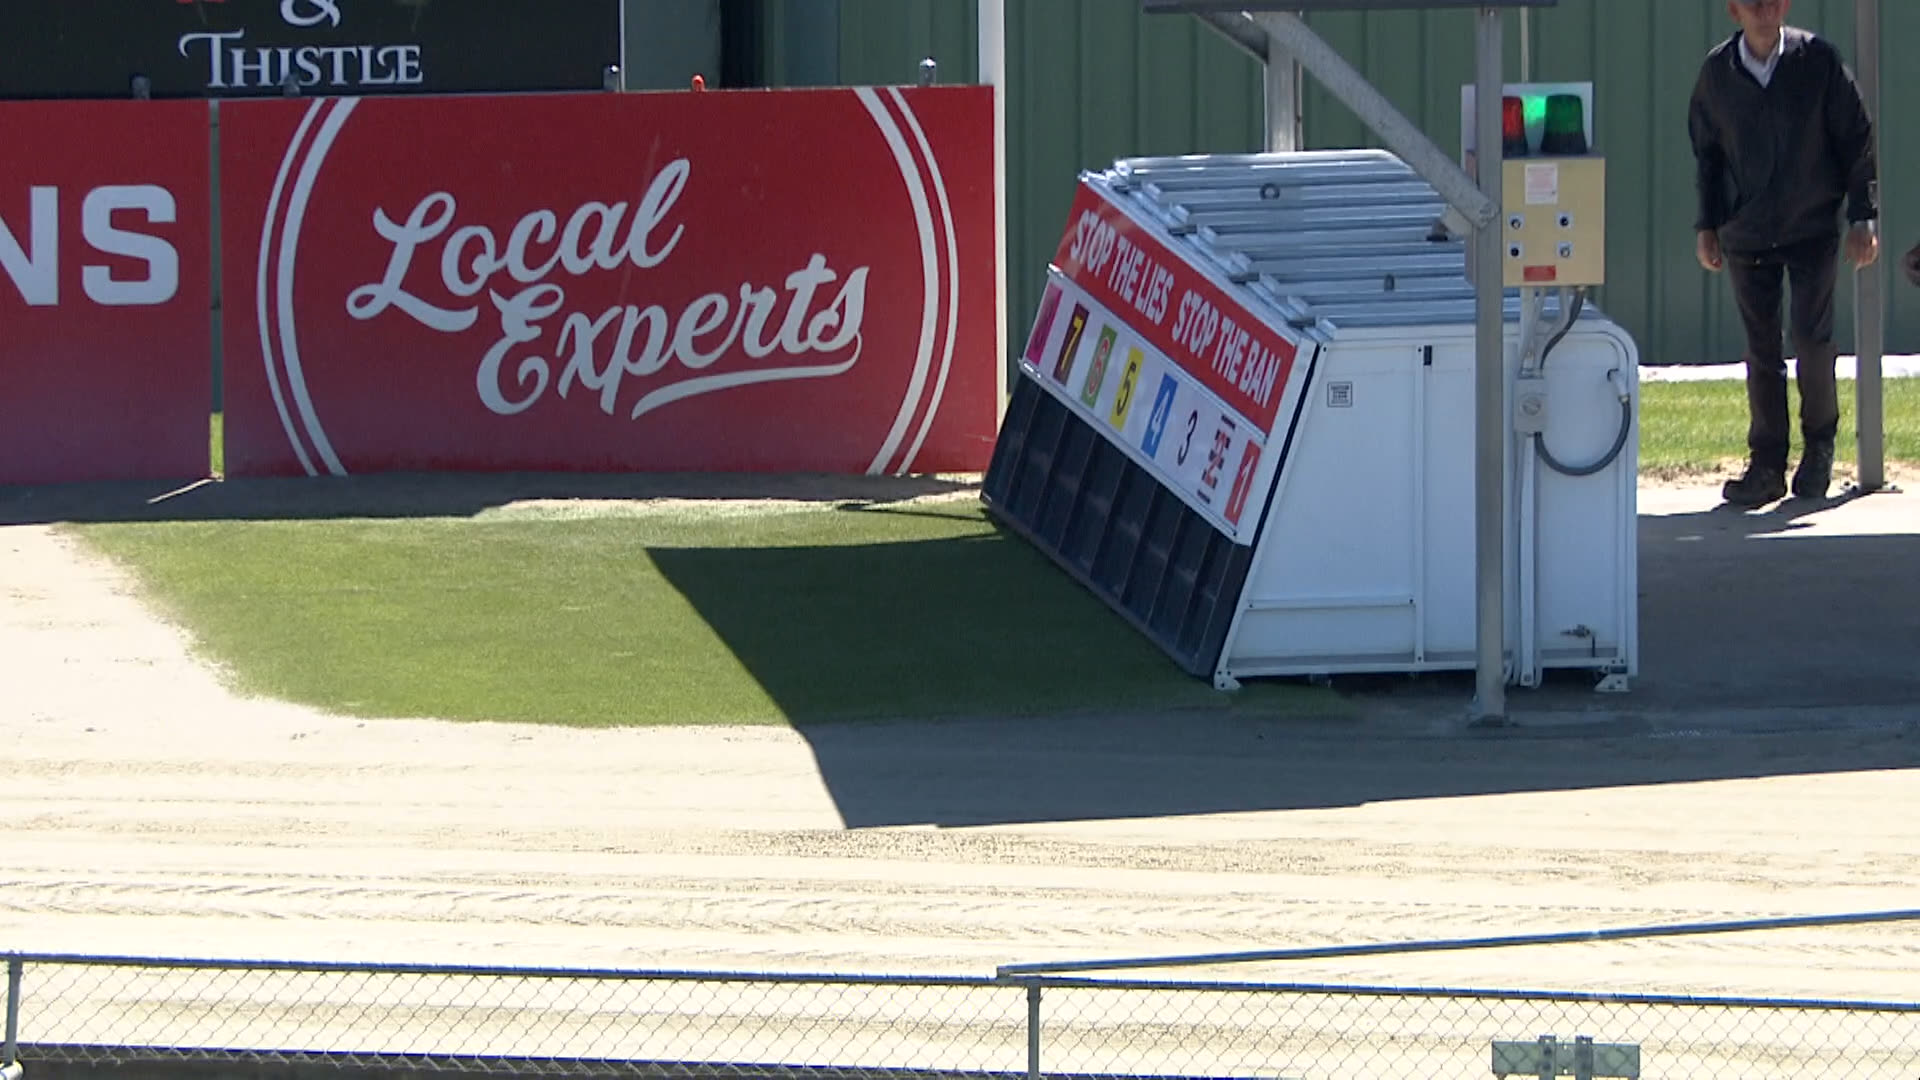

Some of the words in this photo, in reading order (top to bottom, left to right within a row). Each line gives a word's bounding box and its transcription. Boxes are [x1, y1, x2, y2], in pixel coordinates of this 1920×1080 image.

[346, 158, 690, 332] Local
[476, 253, 869, 420] Experts
[1070, 209, 1116, 277] STOP
[1108, 235, 1144, 304] THE
[1135, 256, 1174, 326] LIES
[1172, 289, 1219, 358] STOP
[1211, 316, 1250, 385] THE
[1238, 340, 1281, 408] BAN
[1060, 315, 1083, 371] 7
[1117, 362, 1137, 417] 5
[1150, 388, 1170, 446] 4
[1177, 409, 1198, 466] 3
[1233, 455, 1255, 514] 1
